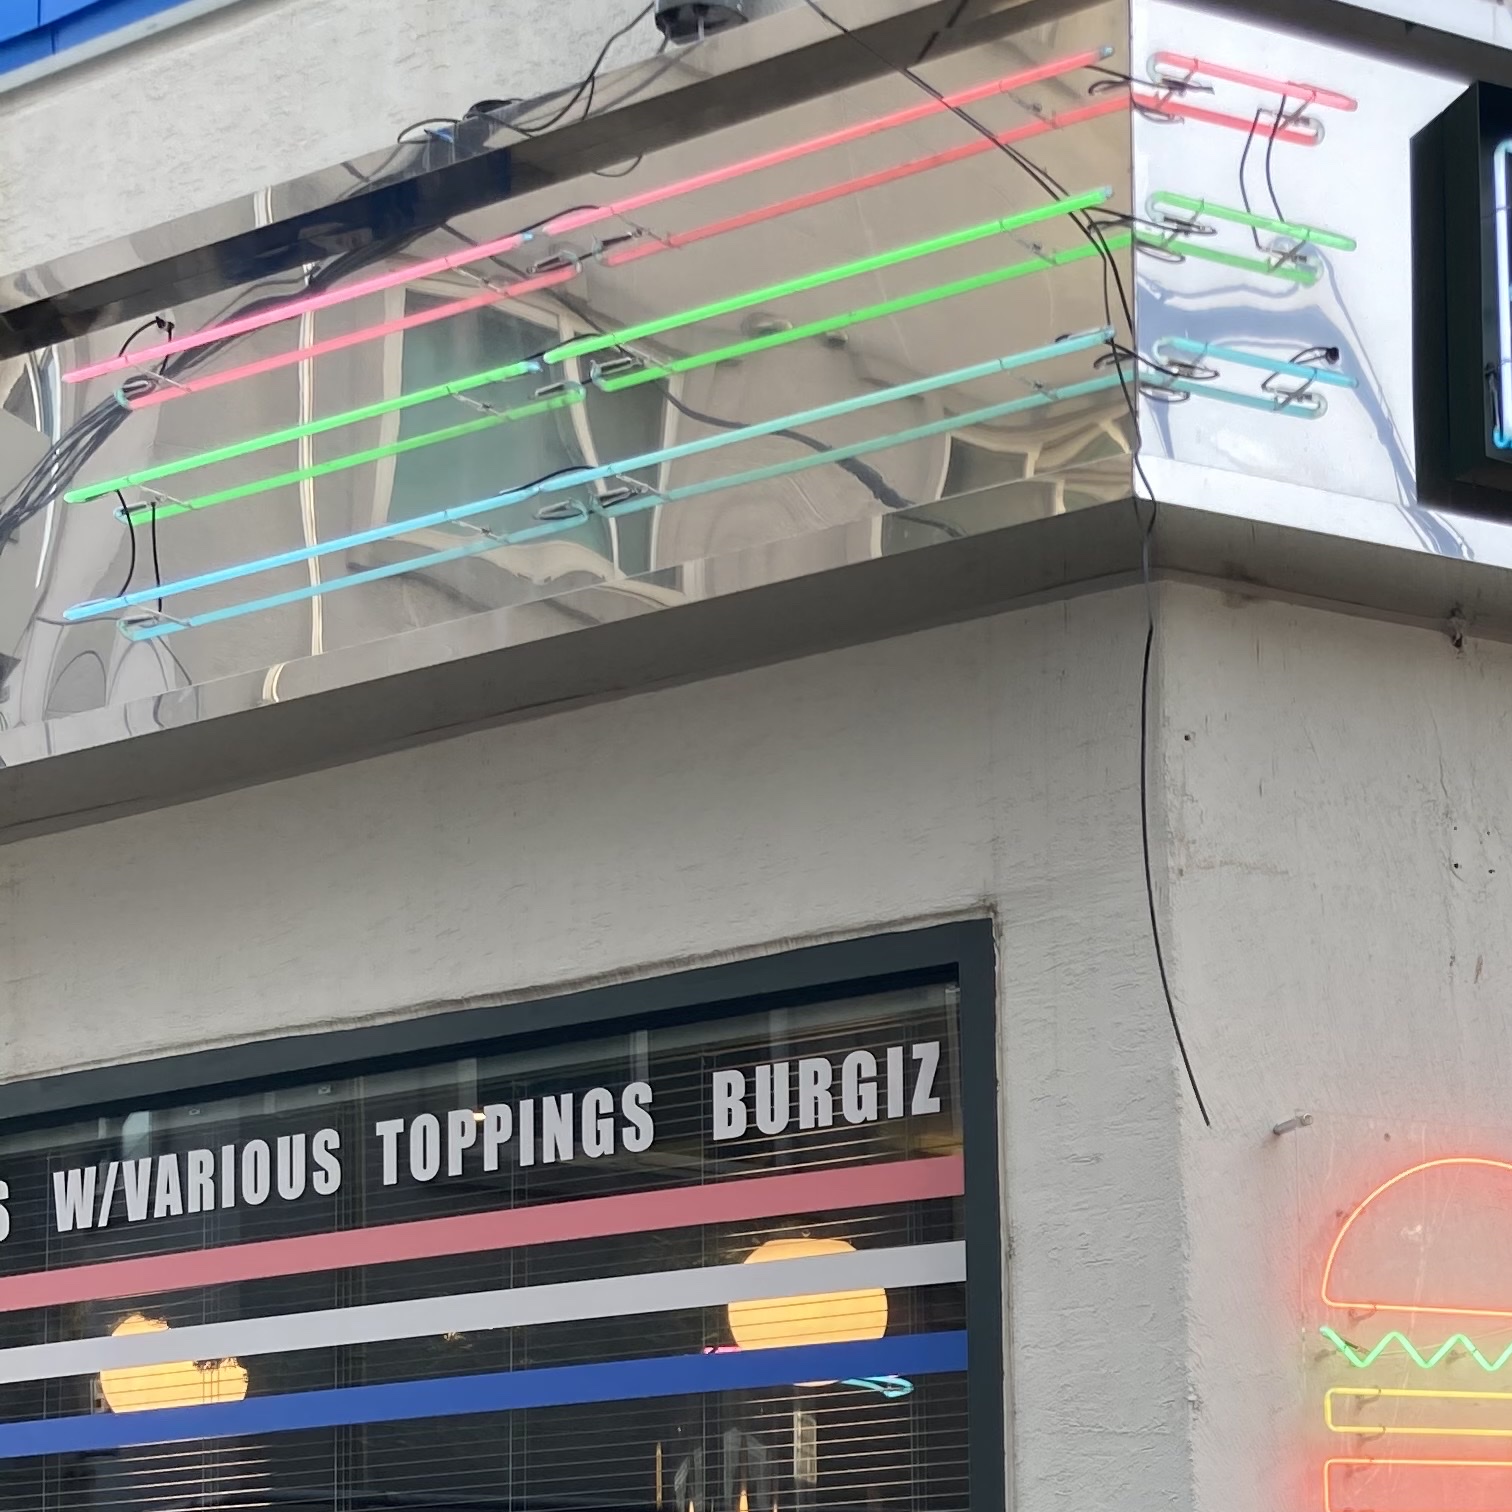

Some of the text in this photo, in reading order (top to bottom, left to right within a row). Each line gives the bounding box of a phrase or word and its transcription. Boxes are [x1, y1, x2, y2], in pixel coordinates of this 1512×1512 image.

[53, 1128, 341, 1233] W/VARIOUS
[375, 1081, 654, 1186] TOPPINGS
[712, 1041, 941, 1141] BURGIZ
